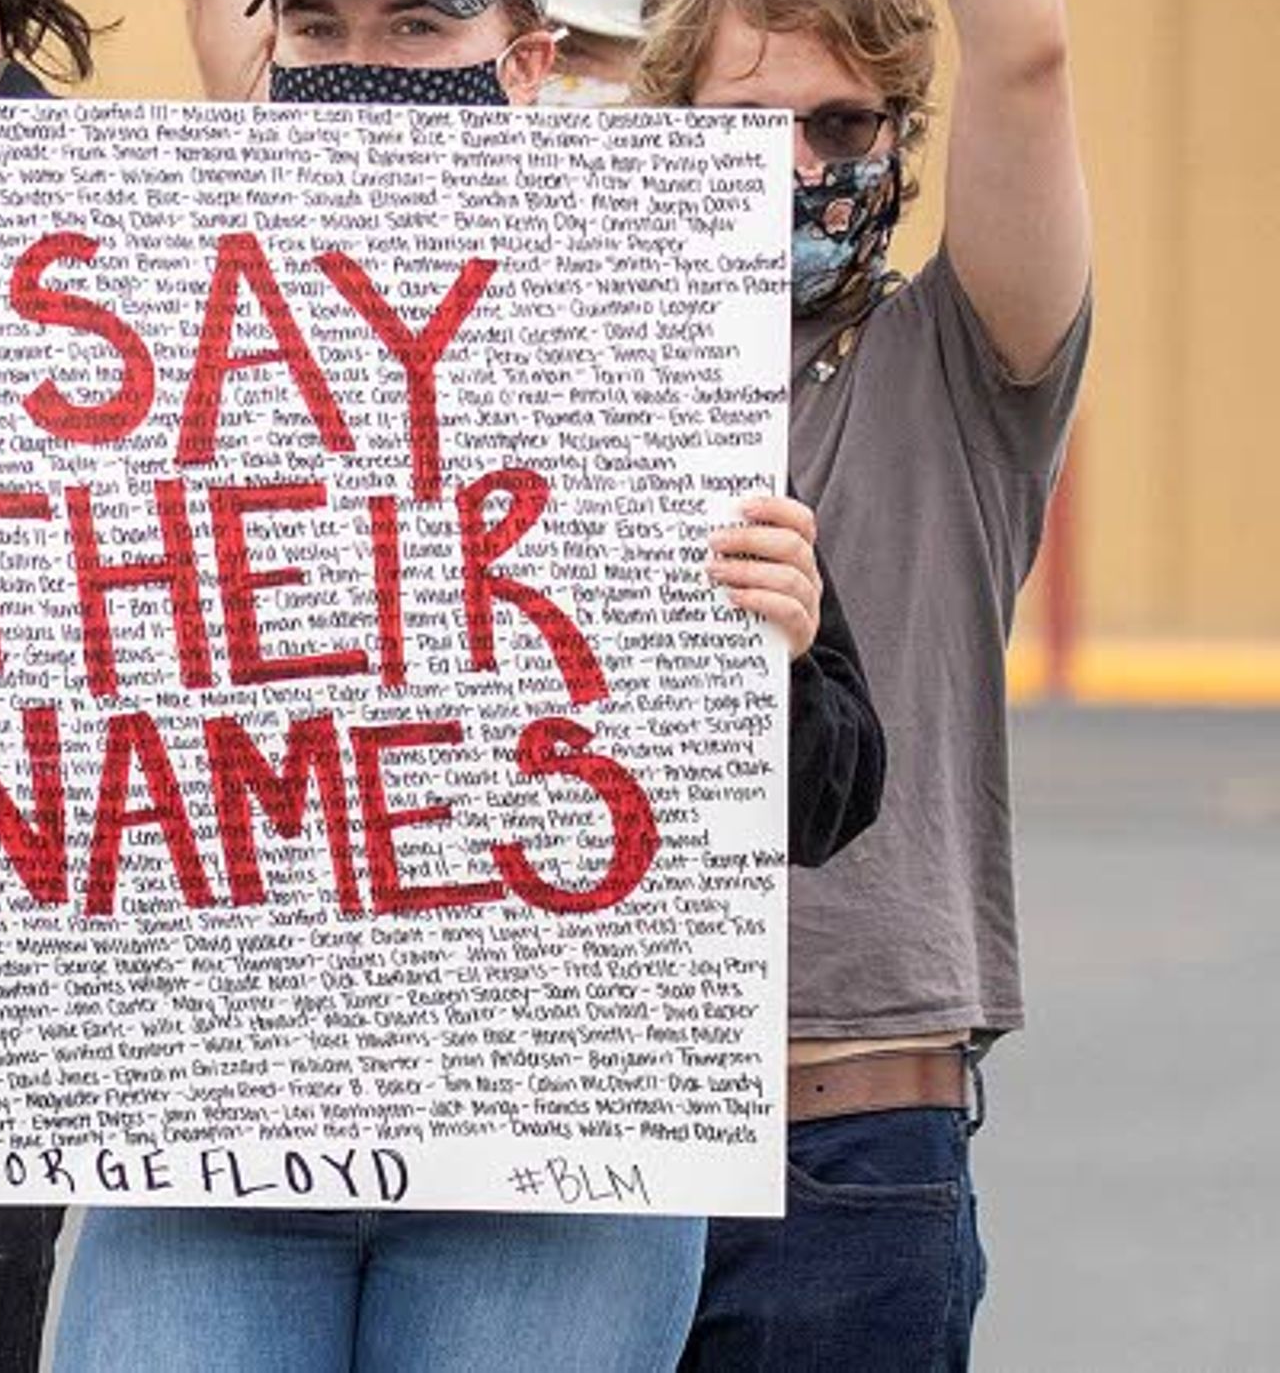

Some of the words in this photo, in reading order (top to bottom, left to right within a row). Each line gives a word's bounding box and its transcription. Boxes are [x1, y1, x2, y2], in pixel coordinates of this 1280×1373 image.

[11, 232, 497, 503] SAY
[200, 1147, 409, 1204] FLOYD
[508, 1154, 652, 1207] #BLM
